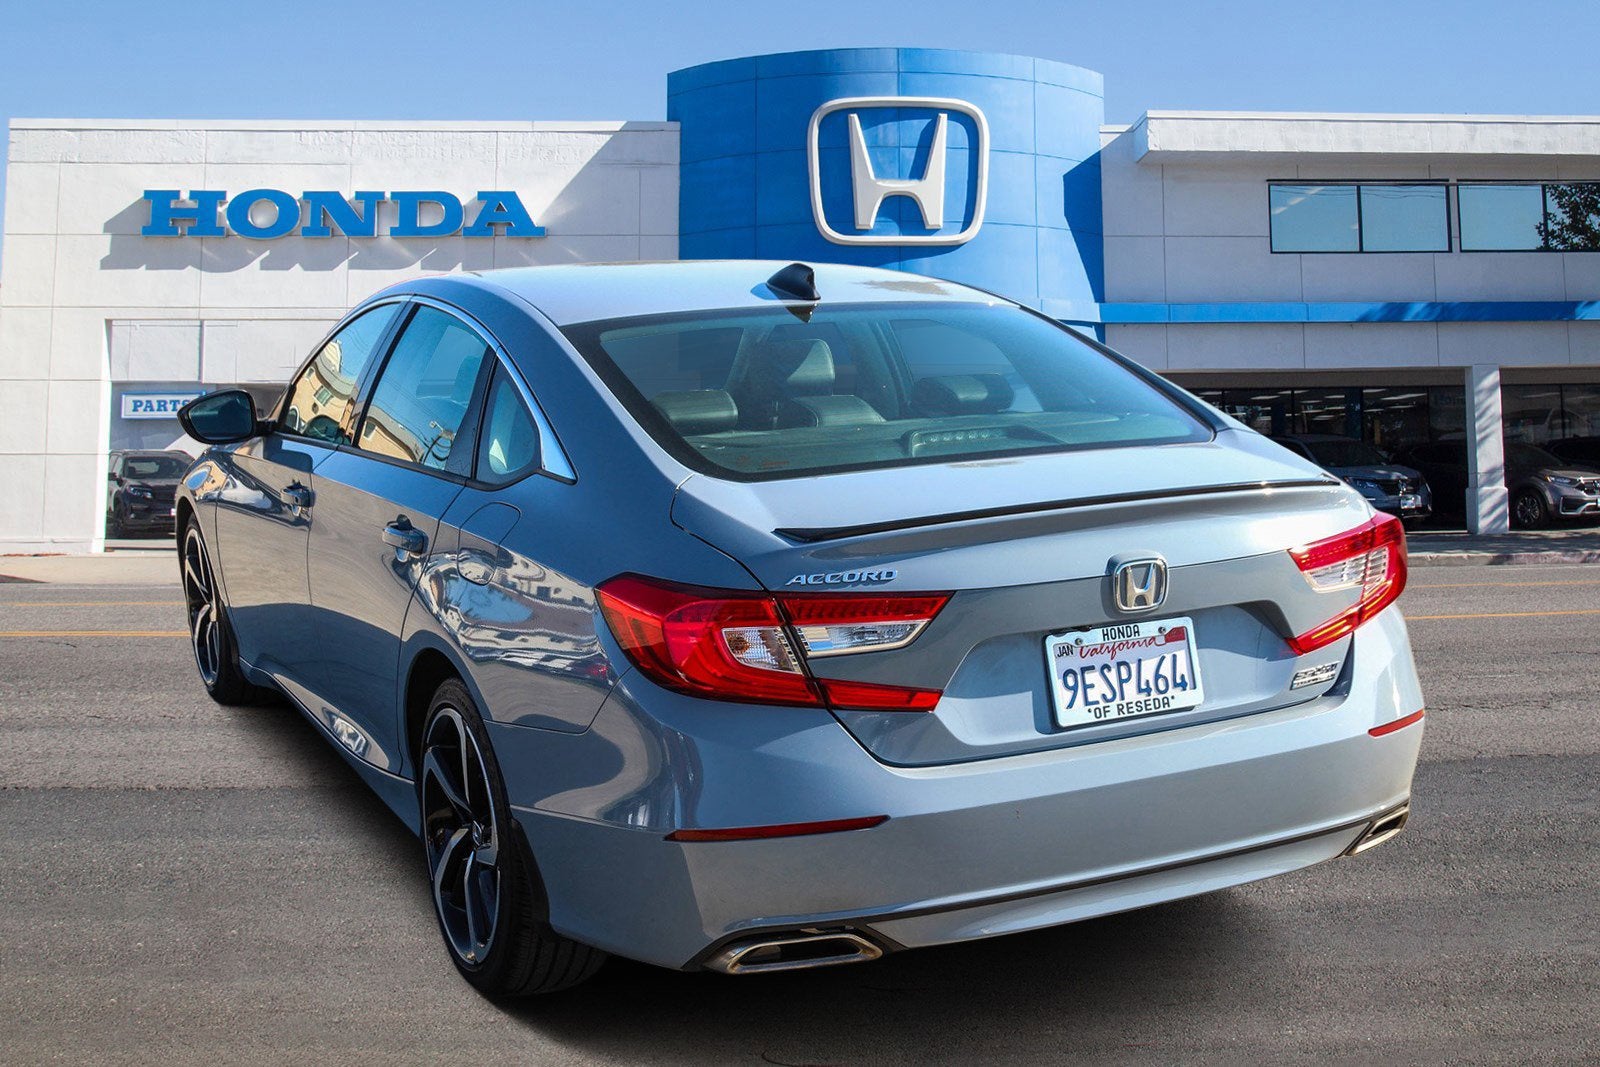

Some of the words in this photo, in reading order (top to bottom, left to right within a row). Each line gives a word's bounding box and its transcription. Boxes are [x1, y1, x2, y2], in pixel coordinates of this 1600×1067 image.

[142, 188, 547, 240] HONDA
[785, 568, 898, 585] ACCORD
[1102, 625, 1140, 642] HONDA
[1056, 645, 1074, 658] JAN
[1079, 636, 1157, 660] California
[1062, 653, 1188, 709] 9ESP464
